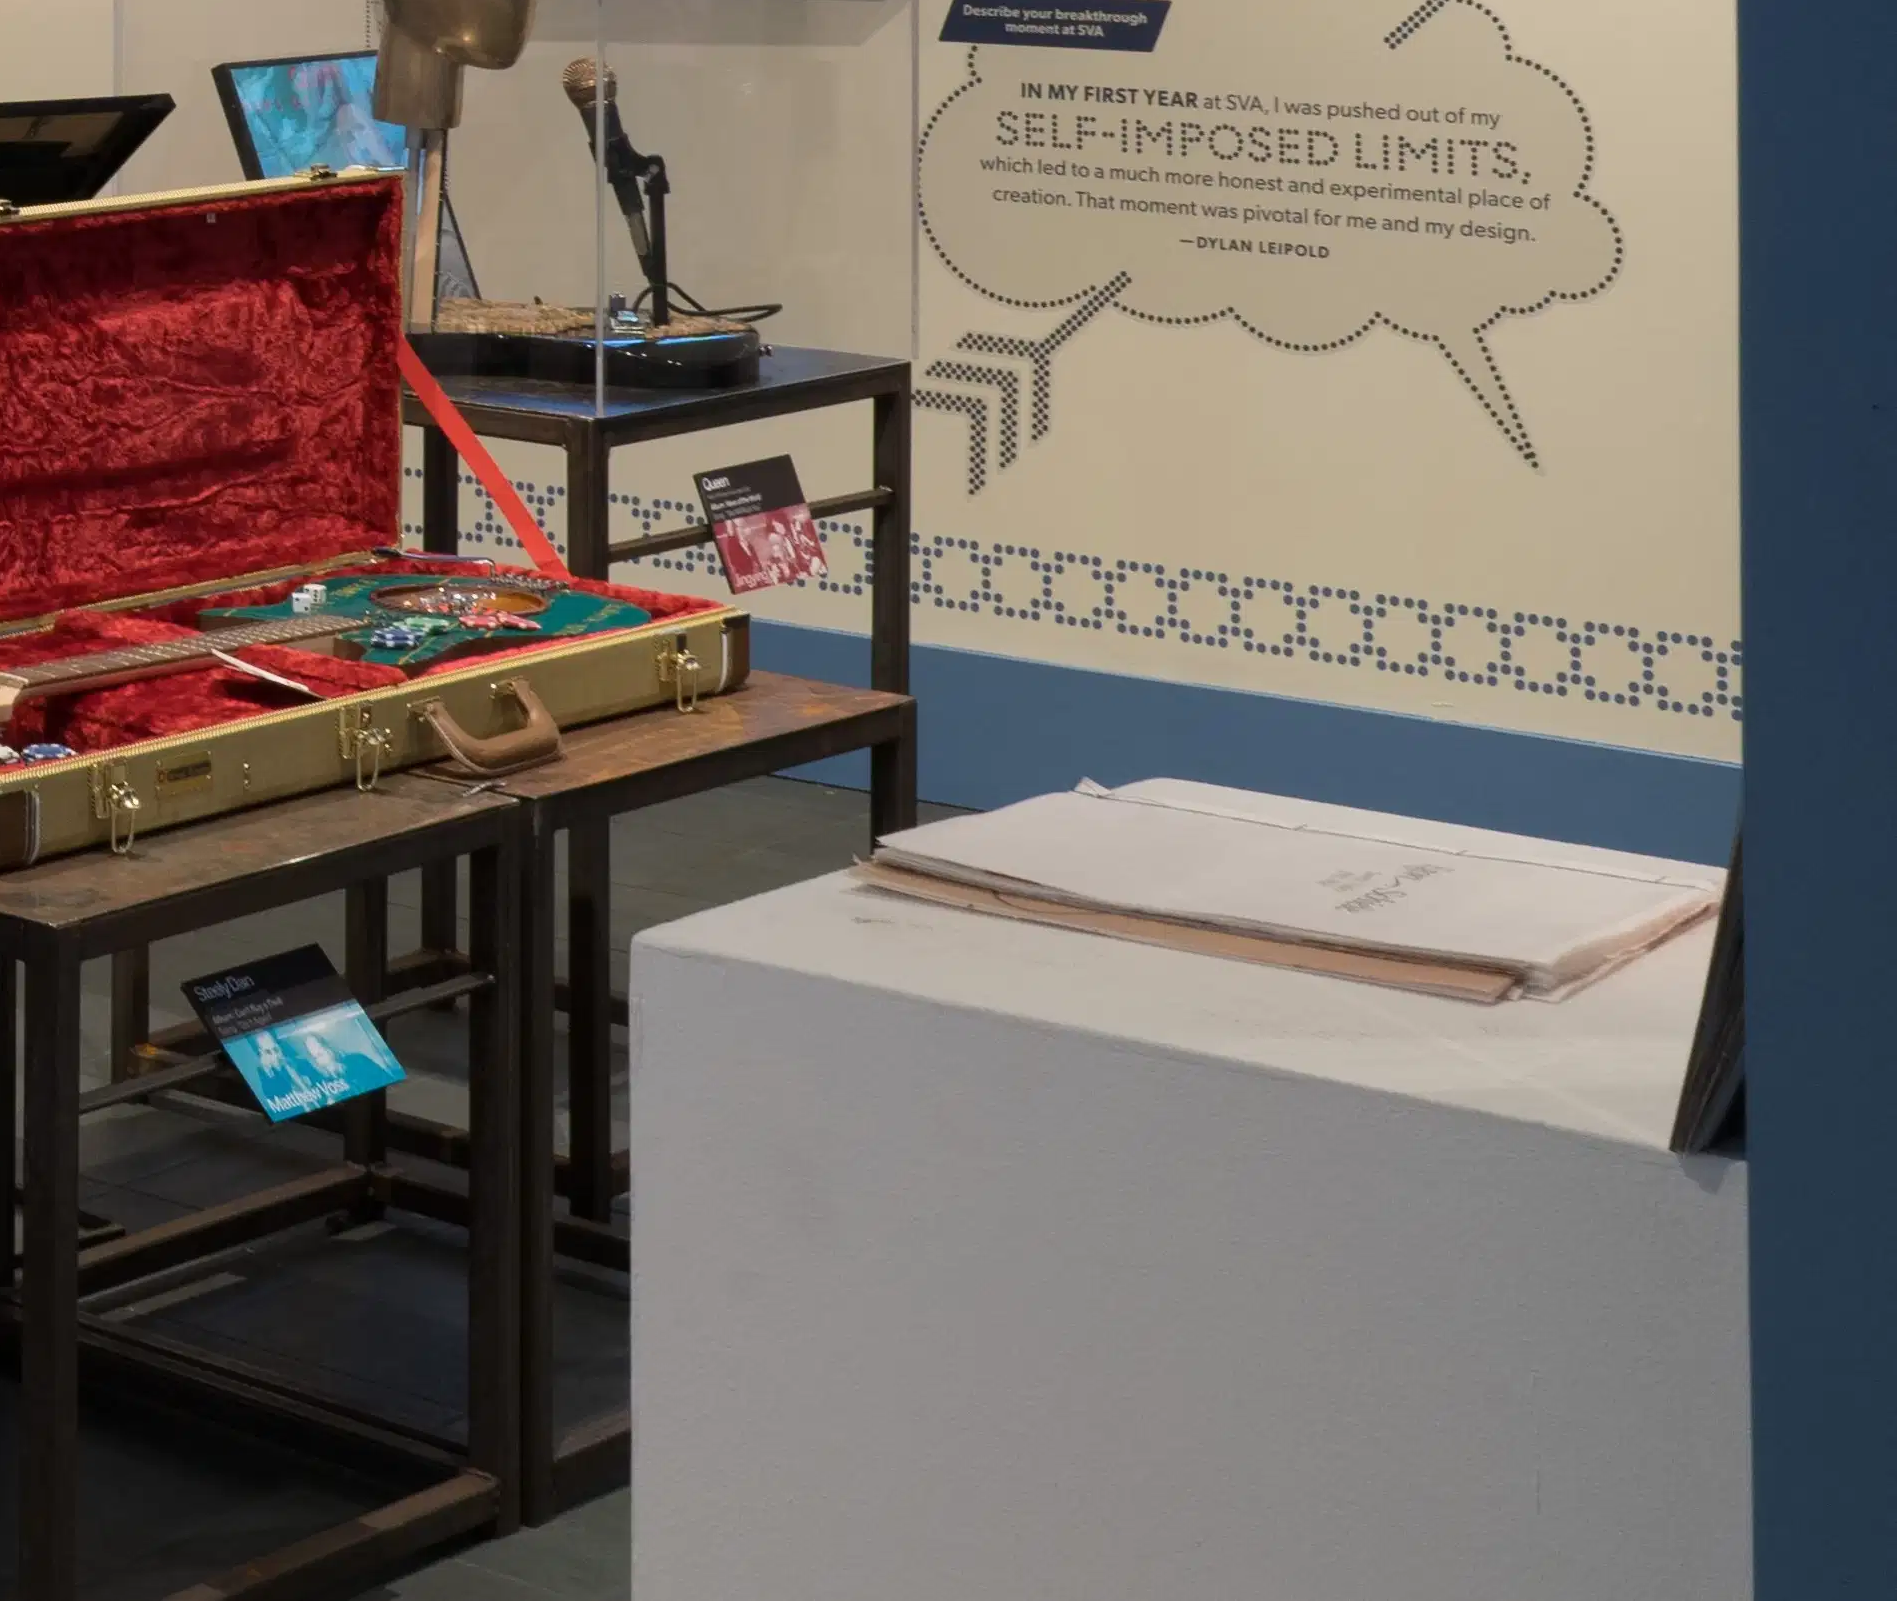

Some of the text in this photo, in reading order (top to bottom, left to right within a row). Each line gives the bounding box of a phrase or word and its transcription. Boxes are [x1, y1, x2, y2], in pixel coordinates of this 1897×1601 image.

[963, 4, 1148, 26] Describe your breakthrough
[1005, 22, 1105, 37] moment at SVA
[1020, 82, 1501, 131] IN MY FIRST YEAR at SVA, I was pushed out of my
[995, 109, 1532, 186] SELF-IMPOSED LIMITS,
[980, 157, 1552, 211] which led to a much more honest and experimental place of
[992, 186, 1537, 245] creation. That moment was pivotal for me and my design.
[1258, 240, 1331, 260] LEIPOLD
[702, 476, 731, 492] Queen
[228, 974, 255, 994] Dan
[267, 1077, 350, 1113] Matthew Voss
